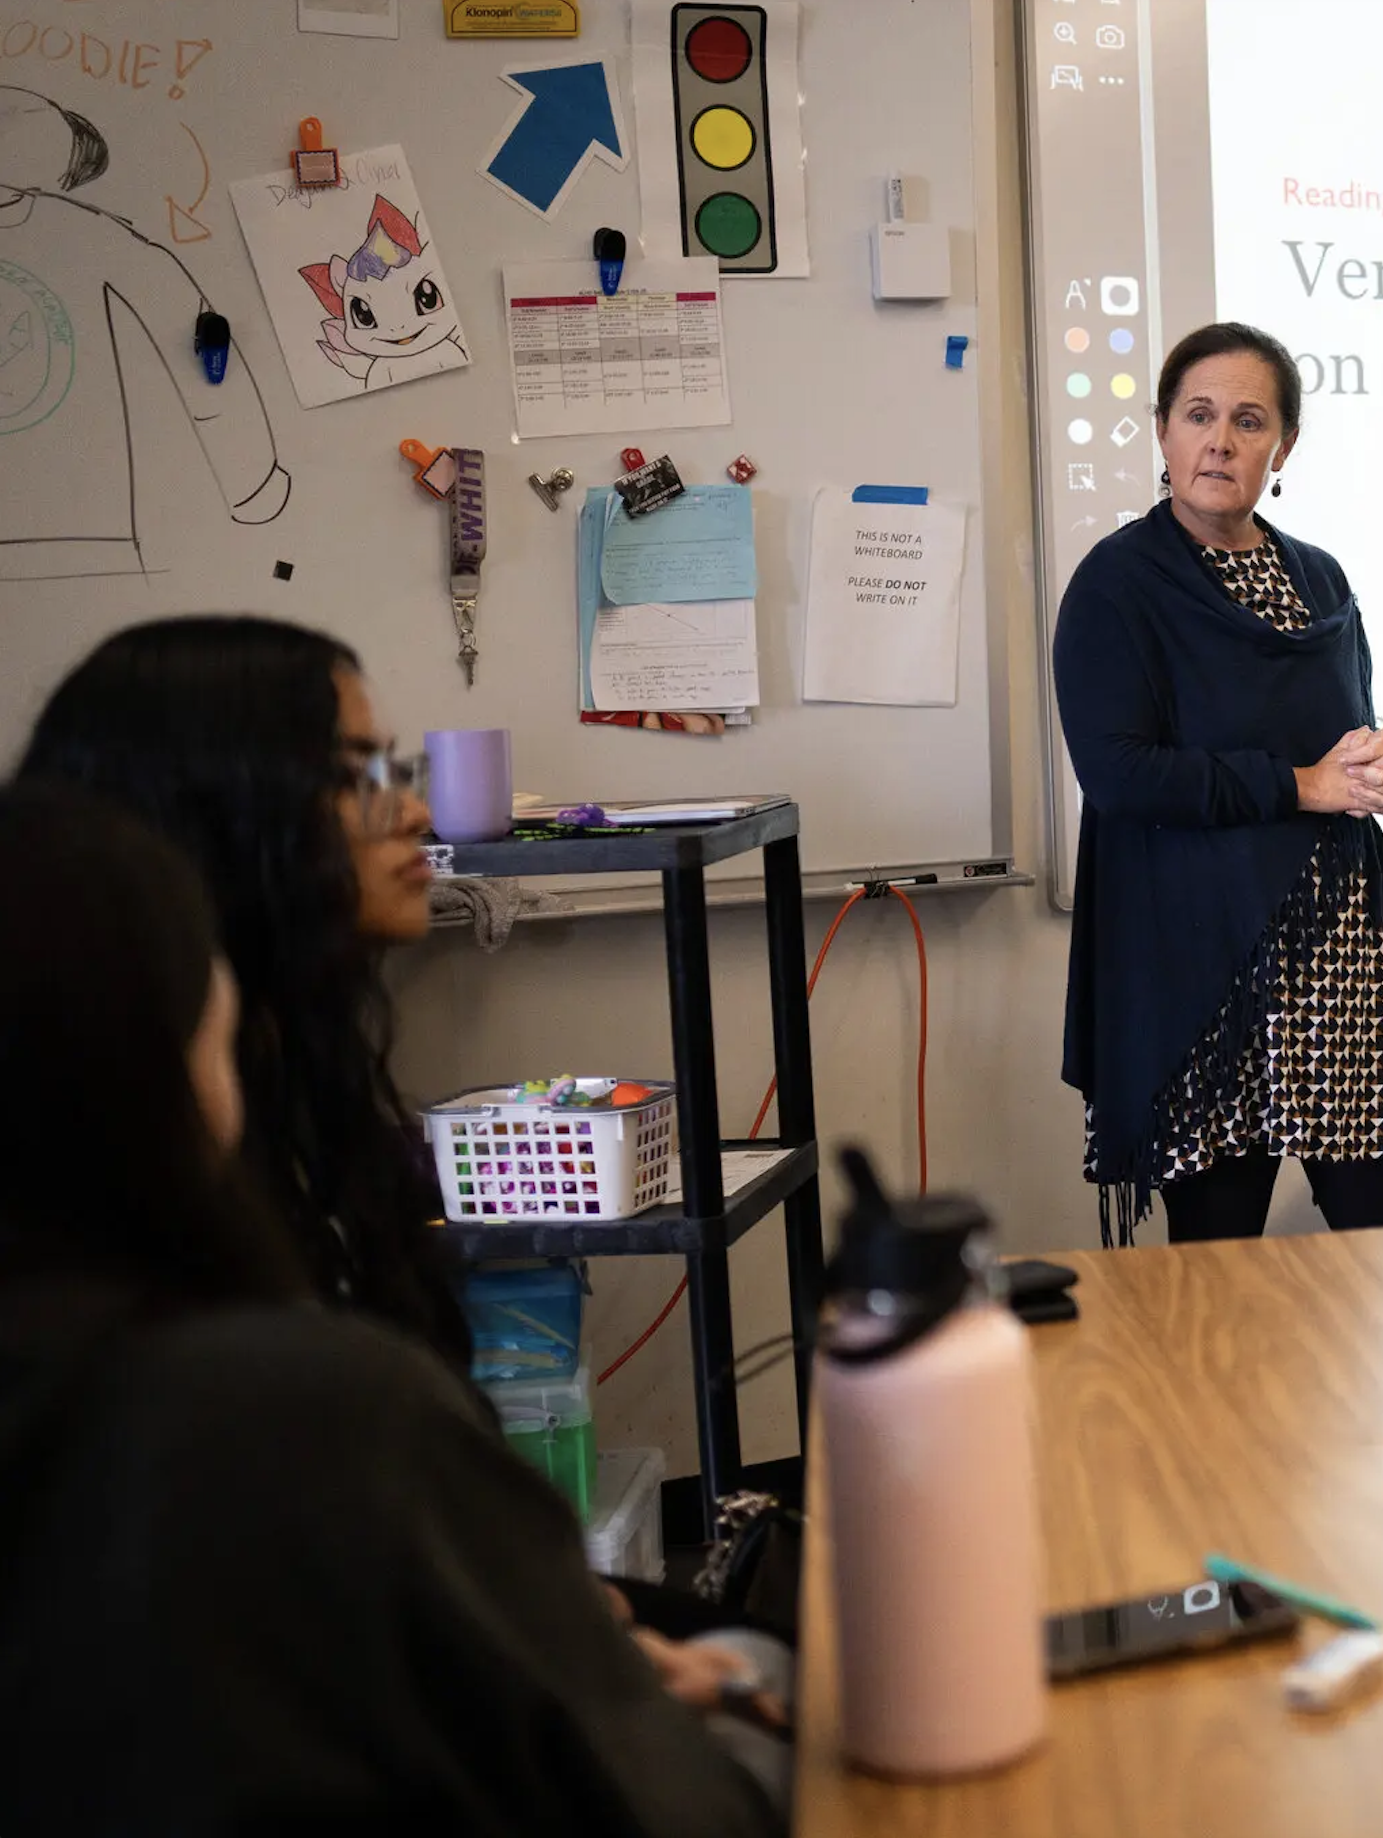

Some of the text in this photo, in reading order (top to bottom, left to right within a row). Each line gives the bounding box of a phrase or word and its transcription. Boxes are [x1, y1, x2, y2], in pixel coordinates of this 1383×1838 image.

[465, 7, 513, 18] Klonopin
[1296, 350, 1370, 395] on
[856, 530, 922, 544] THIS IS NOT A
[854, 546, 923, 560] WHITEBOARD
[847, 576, 927, 591] PLEASE DO NOT
[856, 592, 918, 606] WRITE ON IT
